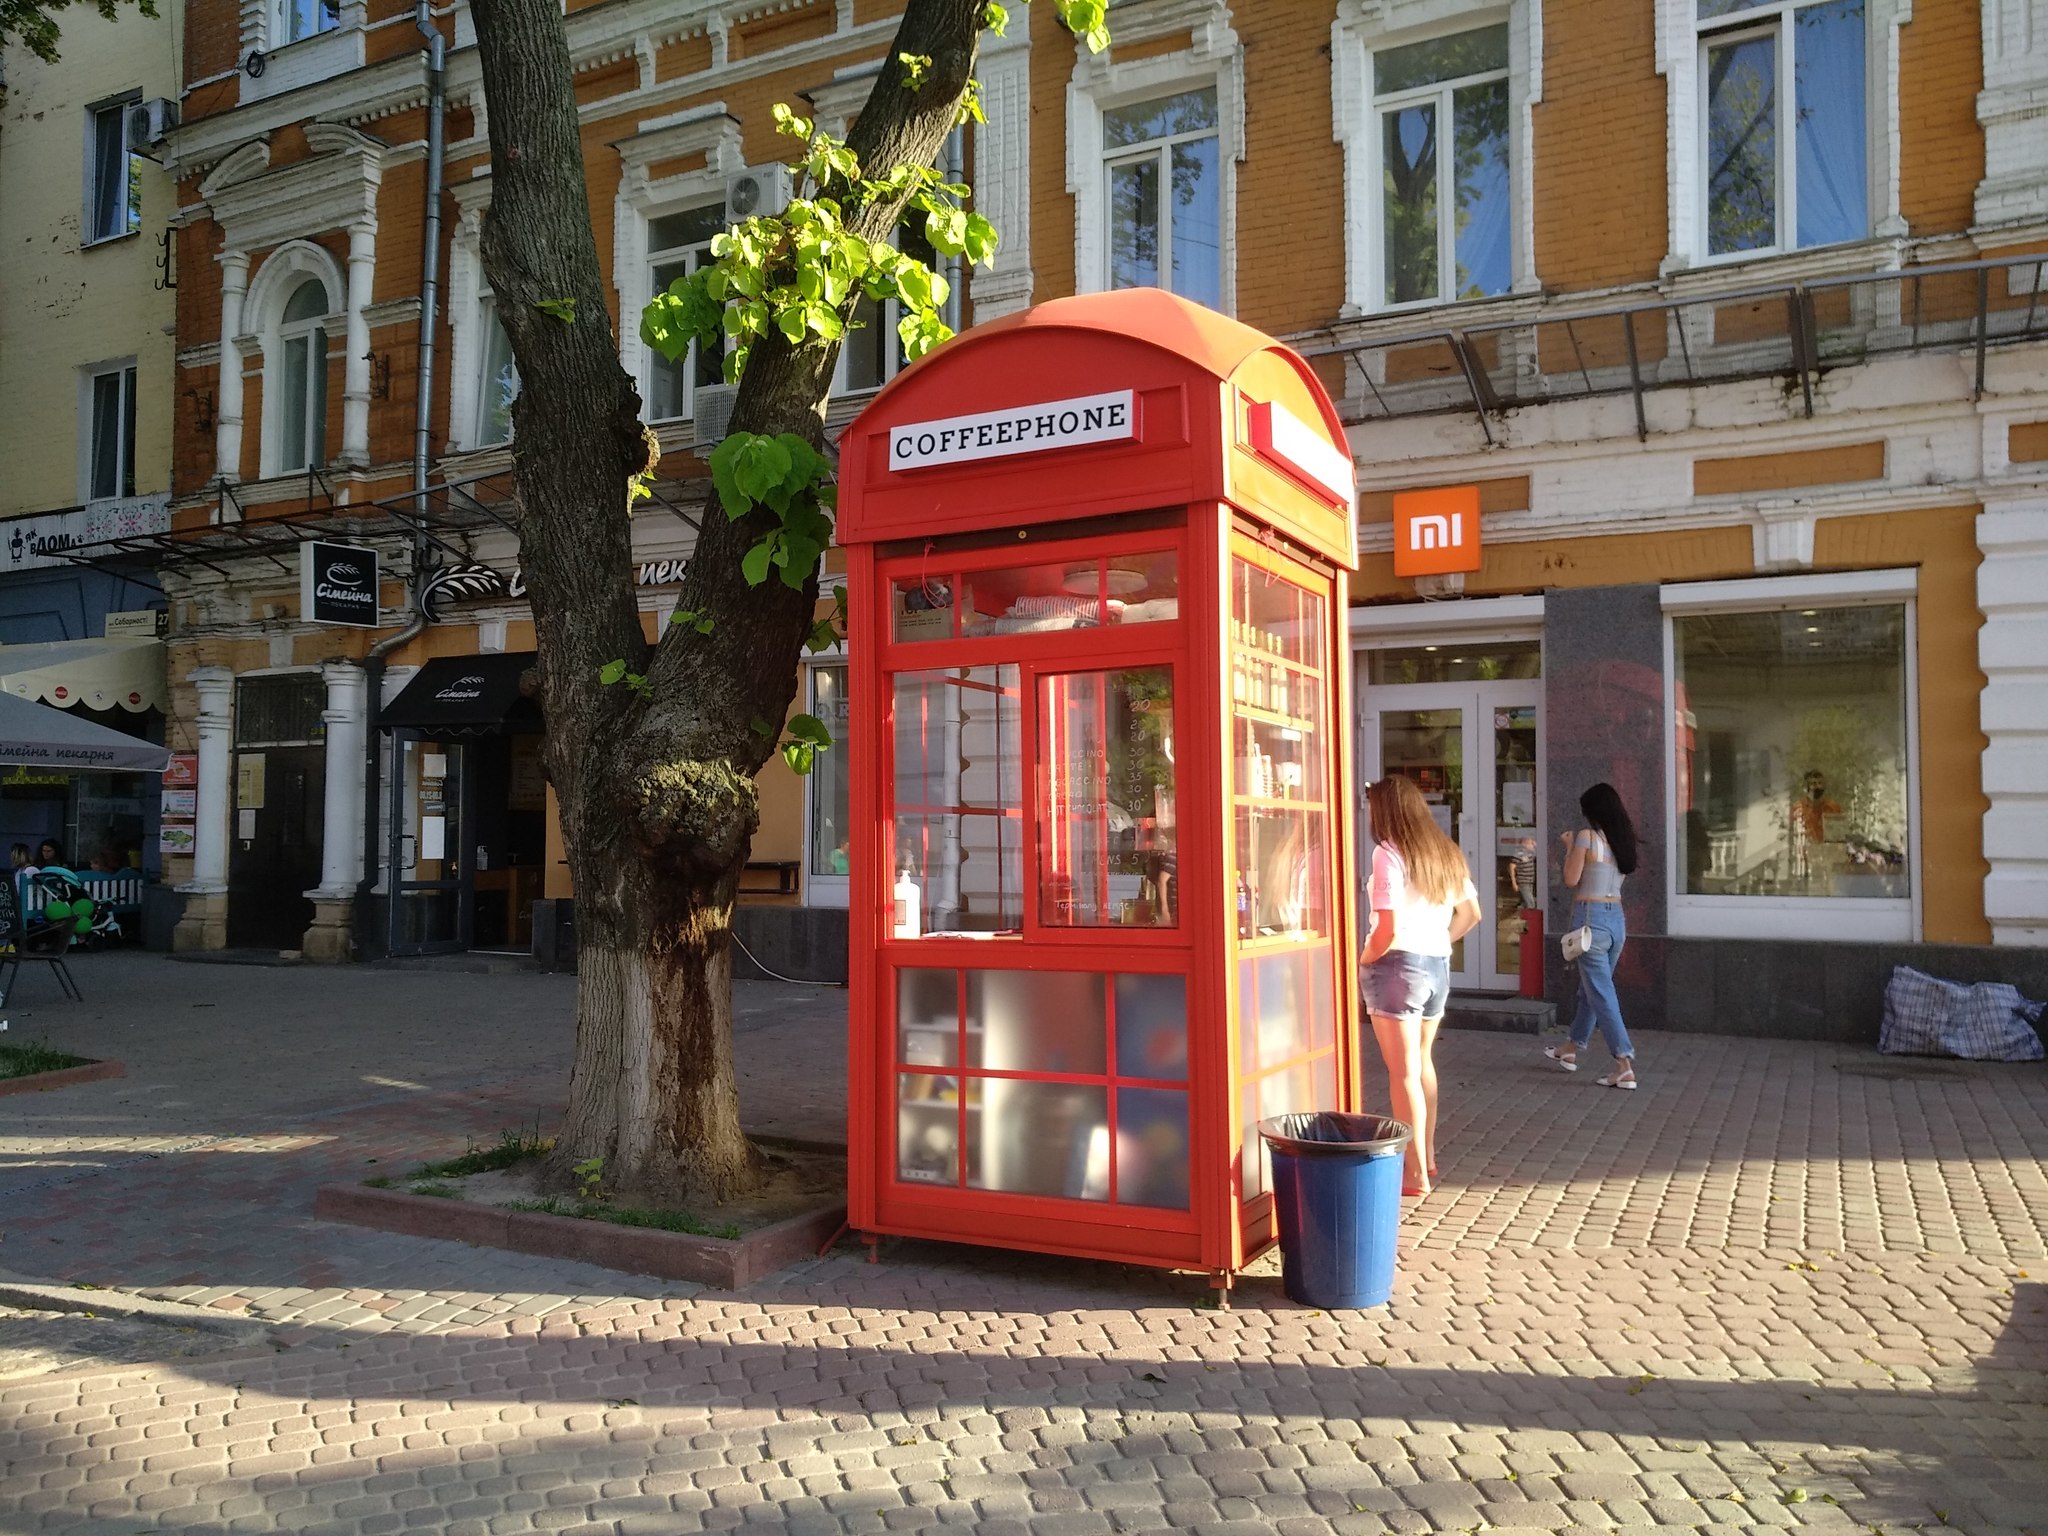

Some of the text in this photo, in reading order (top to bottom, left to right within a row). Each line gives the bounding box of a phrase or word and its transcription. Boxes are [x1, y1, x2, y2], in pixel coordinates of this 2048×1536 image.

[895, 403, 1126, 458] COFFEEPHONE
[639, 559, 688, 585] пек
[316, 583, 374, 603] Сімейна
[158, 613, 169, 626] 27
[56, 747, 114, 764] пекарня
[1127, 799, 1141, 812] 30
